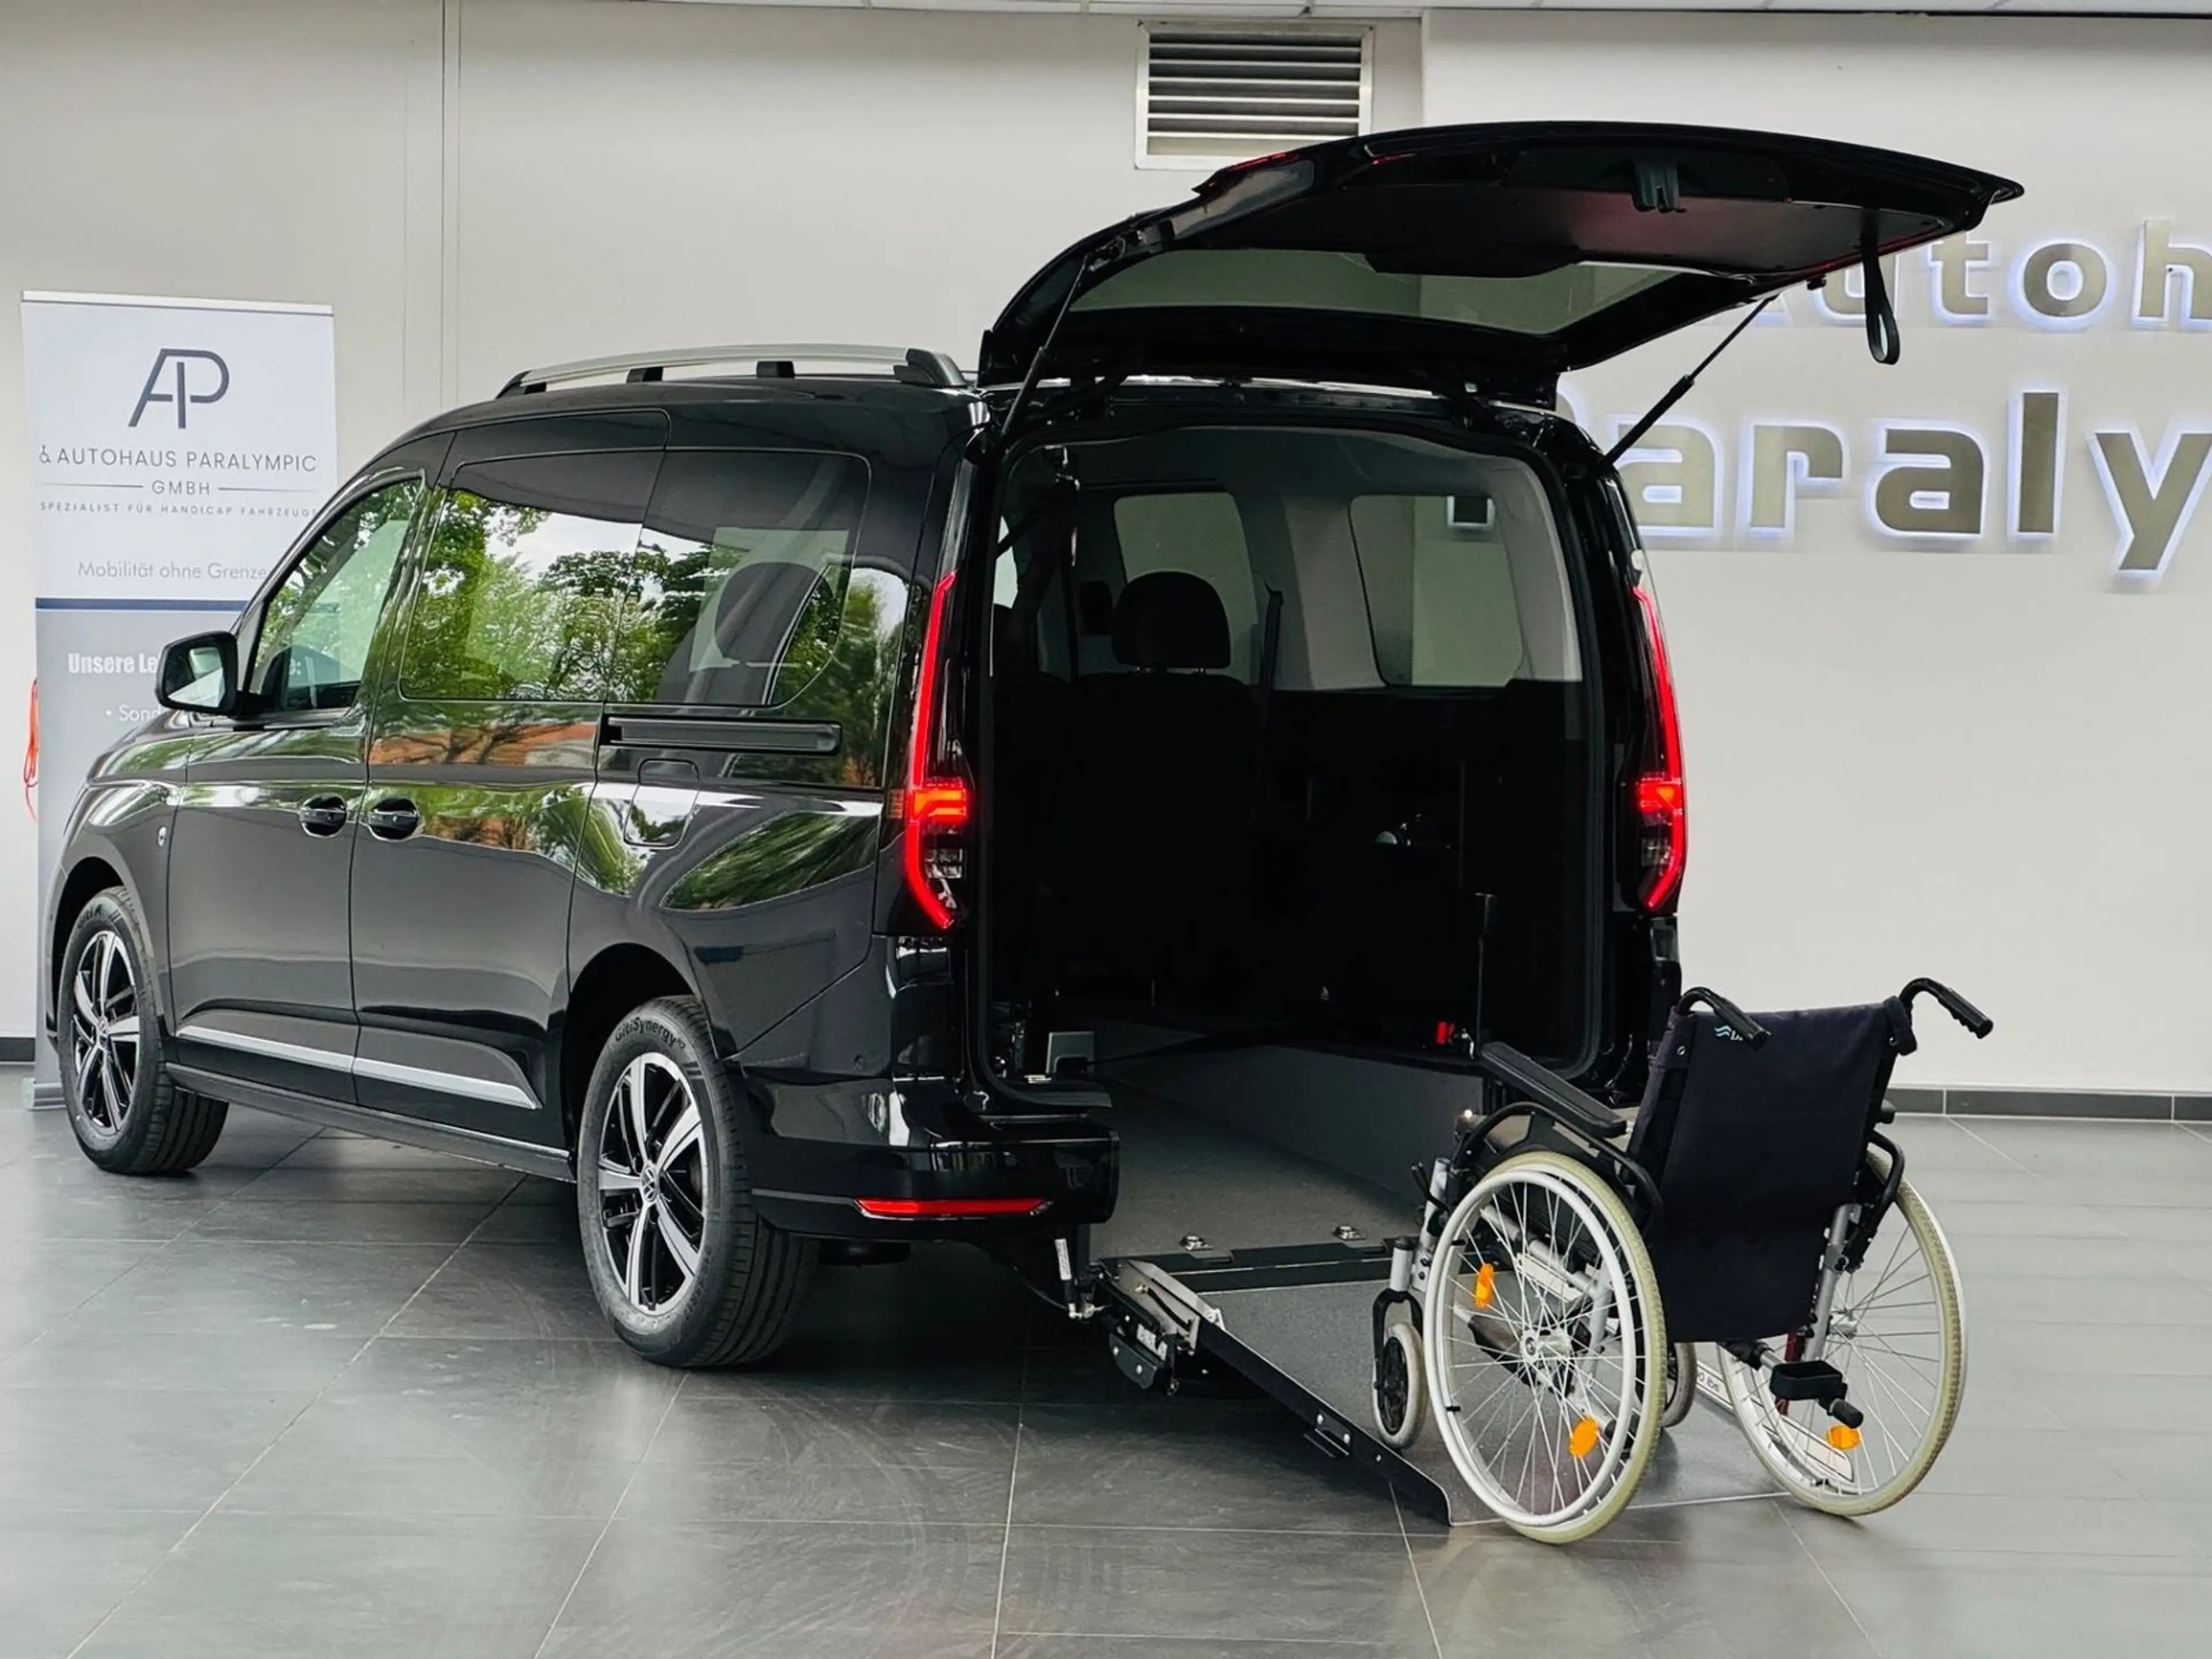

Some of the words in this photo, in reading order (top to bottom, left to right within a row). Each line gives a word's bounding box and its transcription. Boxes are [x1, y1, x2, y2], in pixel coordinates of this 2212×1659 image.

[1755, 220, 2212, 323] utoh
[58, 448, 177, 468] AUTOHAUS
[186, 451, 317, 472] PARALYMPIC
[151, 479, 210, 495] GMBH
[1556, 391, 2212, 570] araly
[40, 501, 119, 512] SPEZIALIST
[161, 504, 233, 516] HANDICAP
[78, 560, 153, 578] Mobilität
[159, 560, 202, 579] ohne
[68, 653, 135, 674] Unsere
